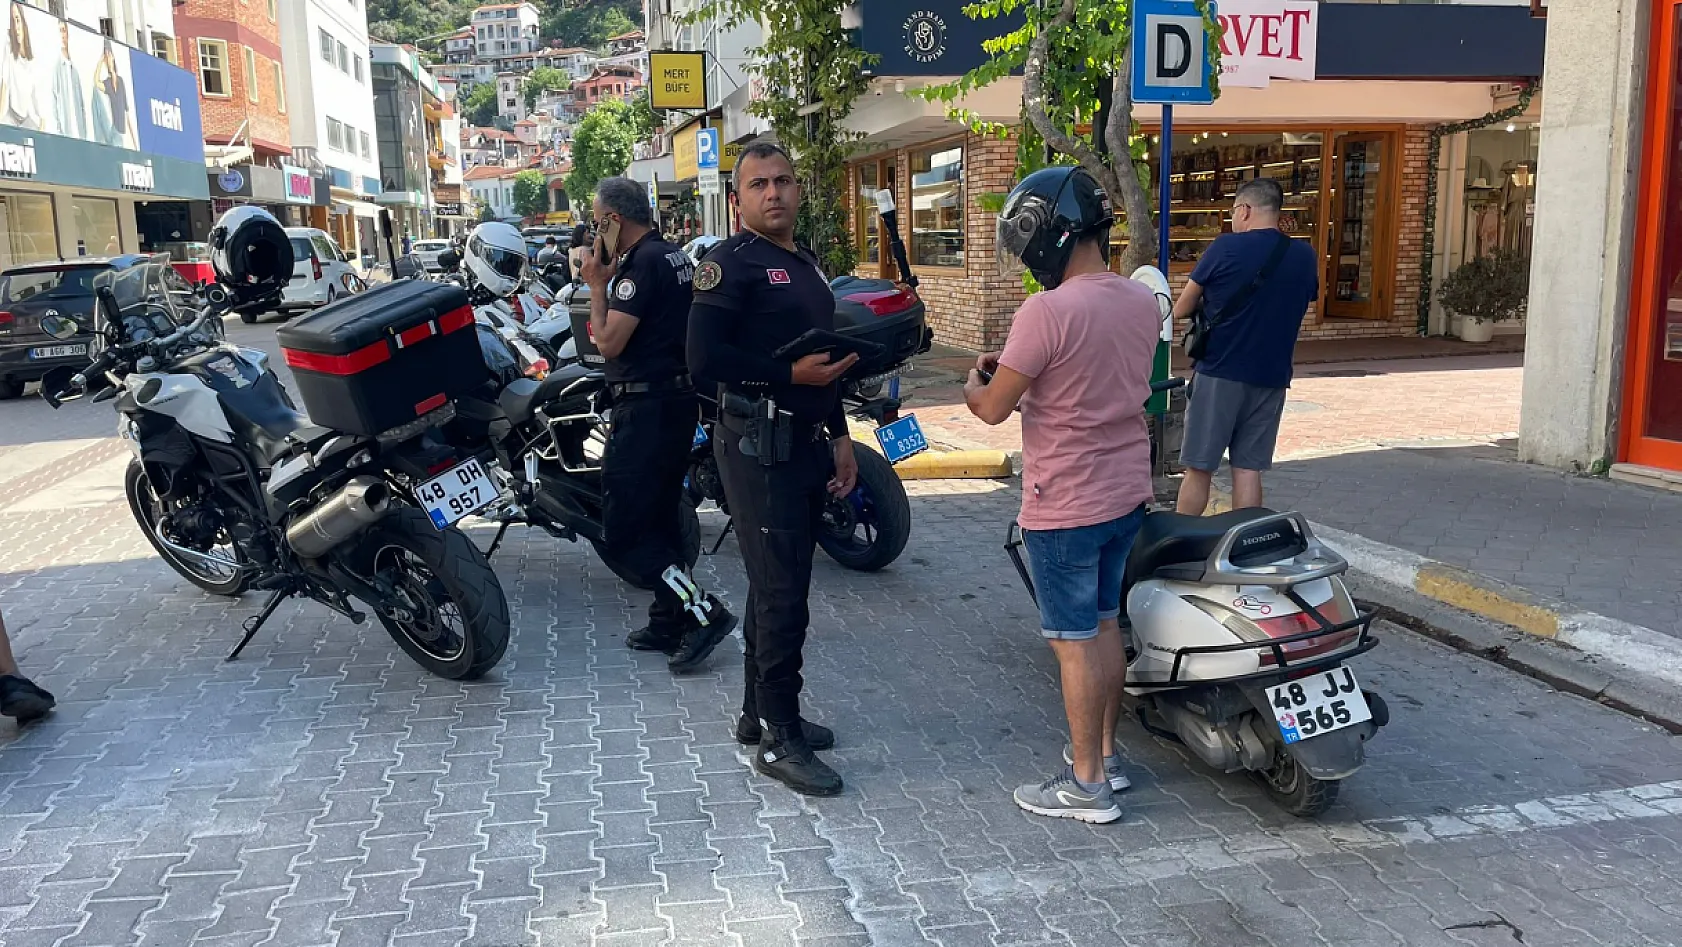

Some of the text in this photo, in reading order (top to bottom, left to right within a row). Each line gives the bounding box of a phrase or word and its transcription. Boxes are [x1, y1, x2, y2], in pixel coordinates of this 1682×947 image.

[902, 10, 947, 31] HAND MADE
[1156, 23, 1192, 77] D
[663, 68, 690, 79] MERT
[665, 81, 690, 93] BÜFE
[151, 97, 183, 131] mavi
[697, 132, 711, 163] P
[121, 159, 154, 189] mavi
[882, 419, 917, 443] 48 A
[898, 433, 923, 452] 8352
[421, 462, 482, 503] 48 DH
[449, 486, 481, 514] 957
[1242, 532, 1281, 546] HONDA
[1274, 667, 1355, 709] 48 JJ
[1296, 700, 1351, 735] 565
[1286, 732, 1298, 742] TR
